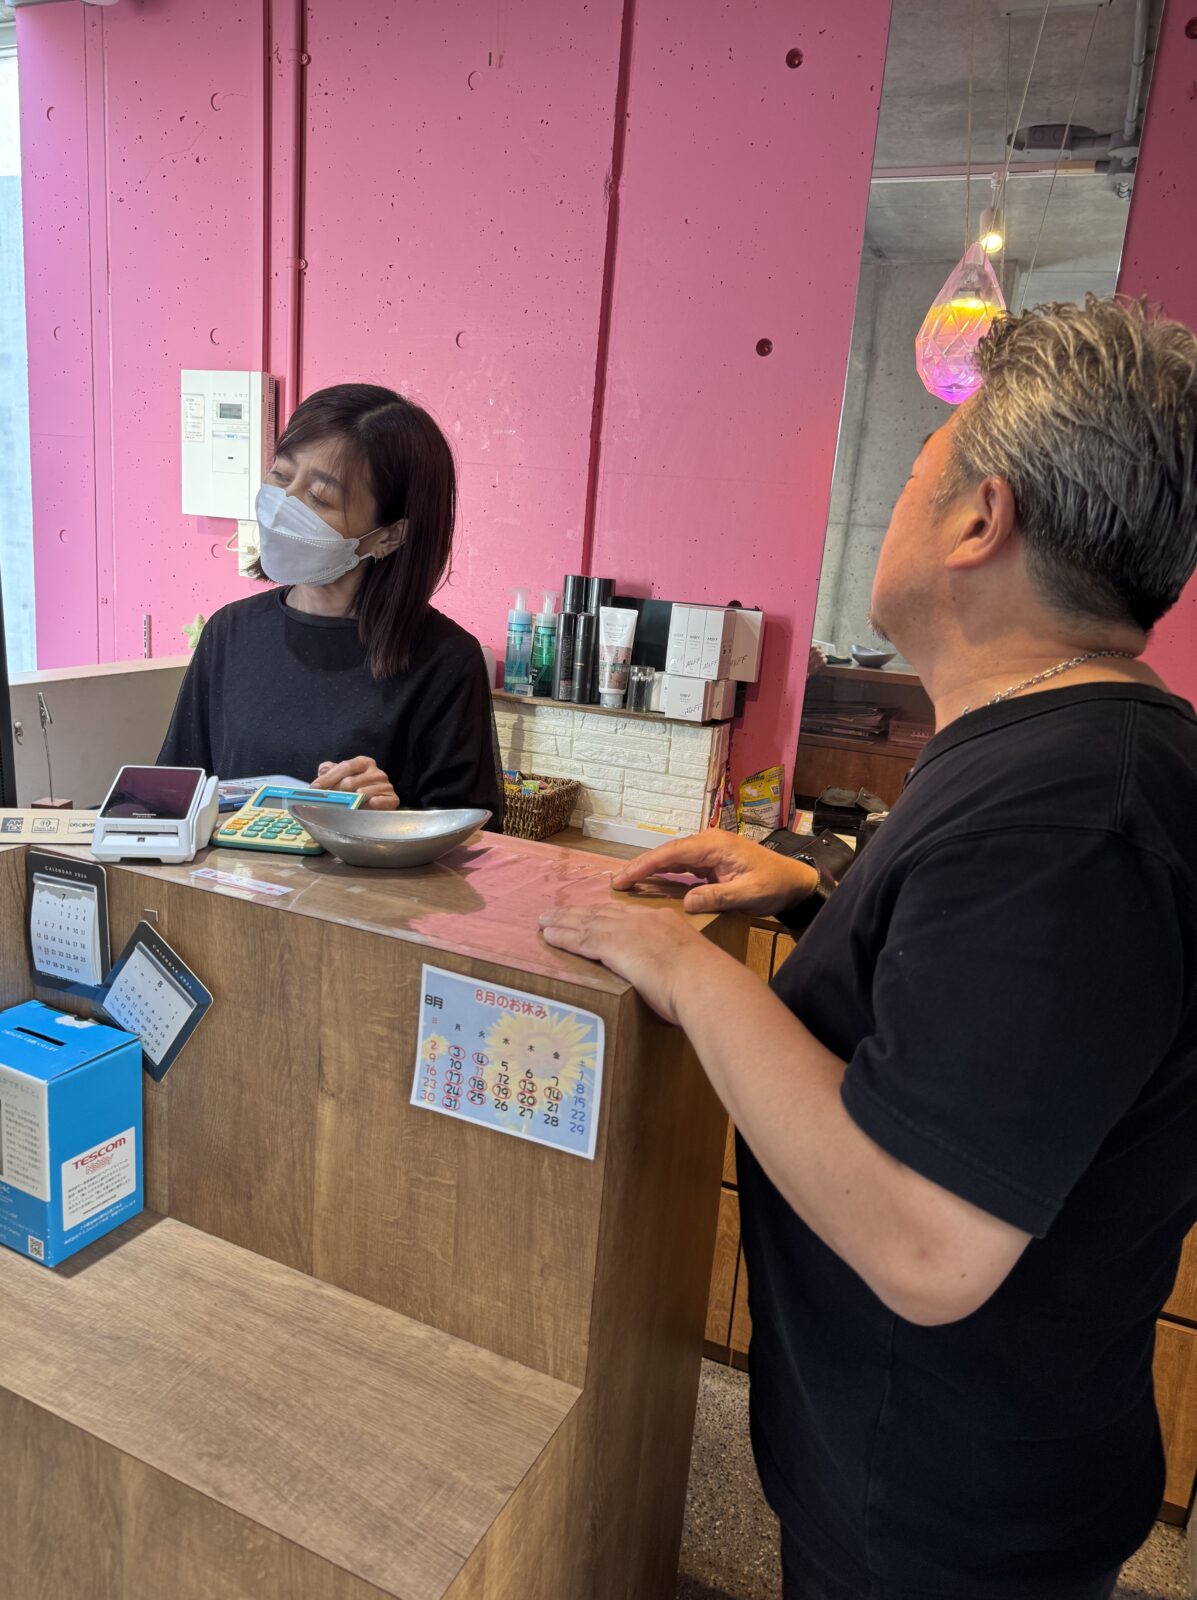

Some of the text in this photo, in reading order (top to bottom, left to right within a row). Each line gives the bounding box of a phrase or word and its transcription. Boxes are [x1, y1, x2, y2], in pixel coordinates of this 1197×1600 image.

[425, 995, 443, 1009] 8月
[476, 989, 547, 1019] 8月のお休み
[429, 1053, 585, 1108] 9 10 11 12 13 14 15
[430, 1040, 584, 1094] 2 3 4 5 6 7 8
[579, 1071, 583, 1080] 1
[421, 1090, 457, 1108] 30 31
[424, 1078, 584, 1135] 23 24 25 26 27 28 29
[426, 1065, 585, 1122] 16 17 18 19 20 21 22
[72, 1137, 126, 1170] TESCOM
